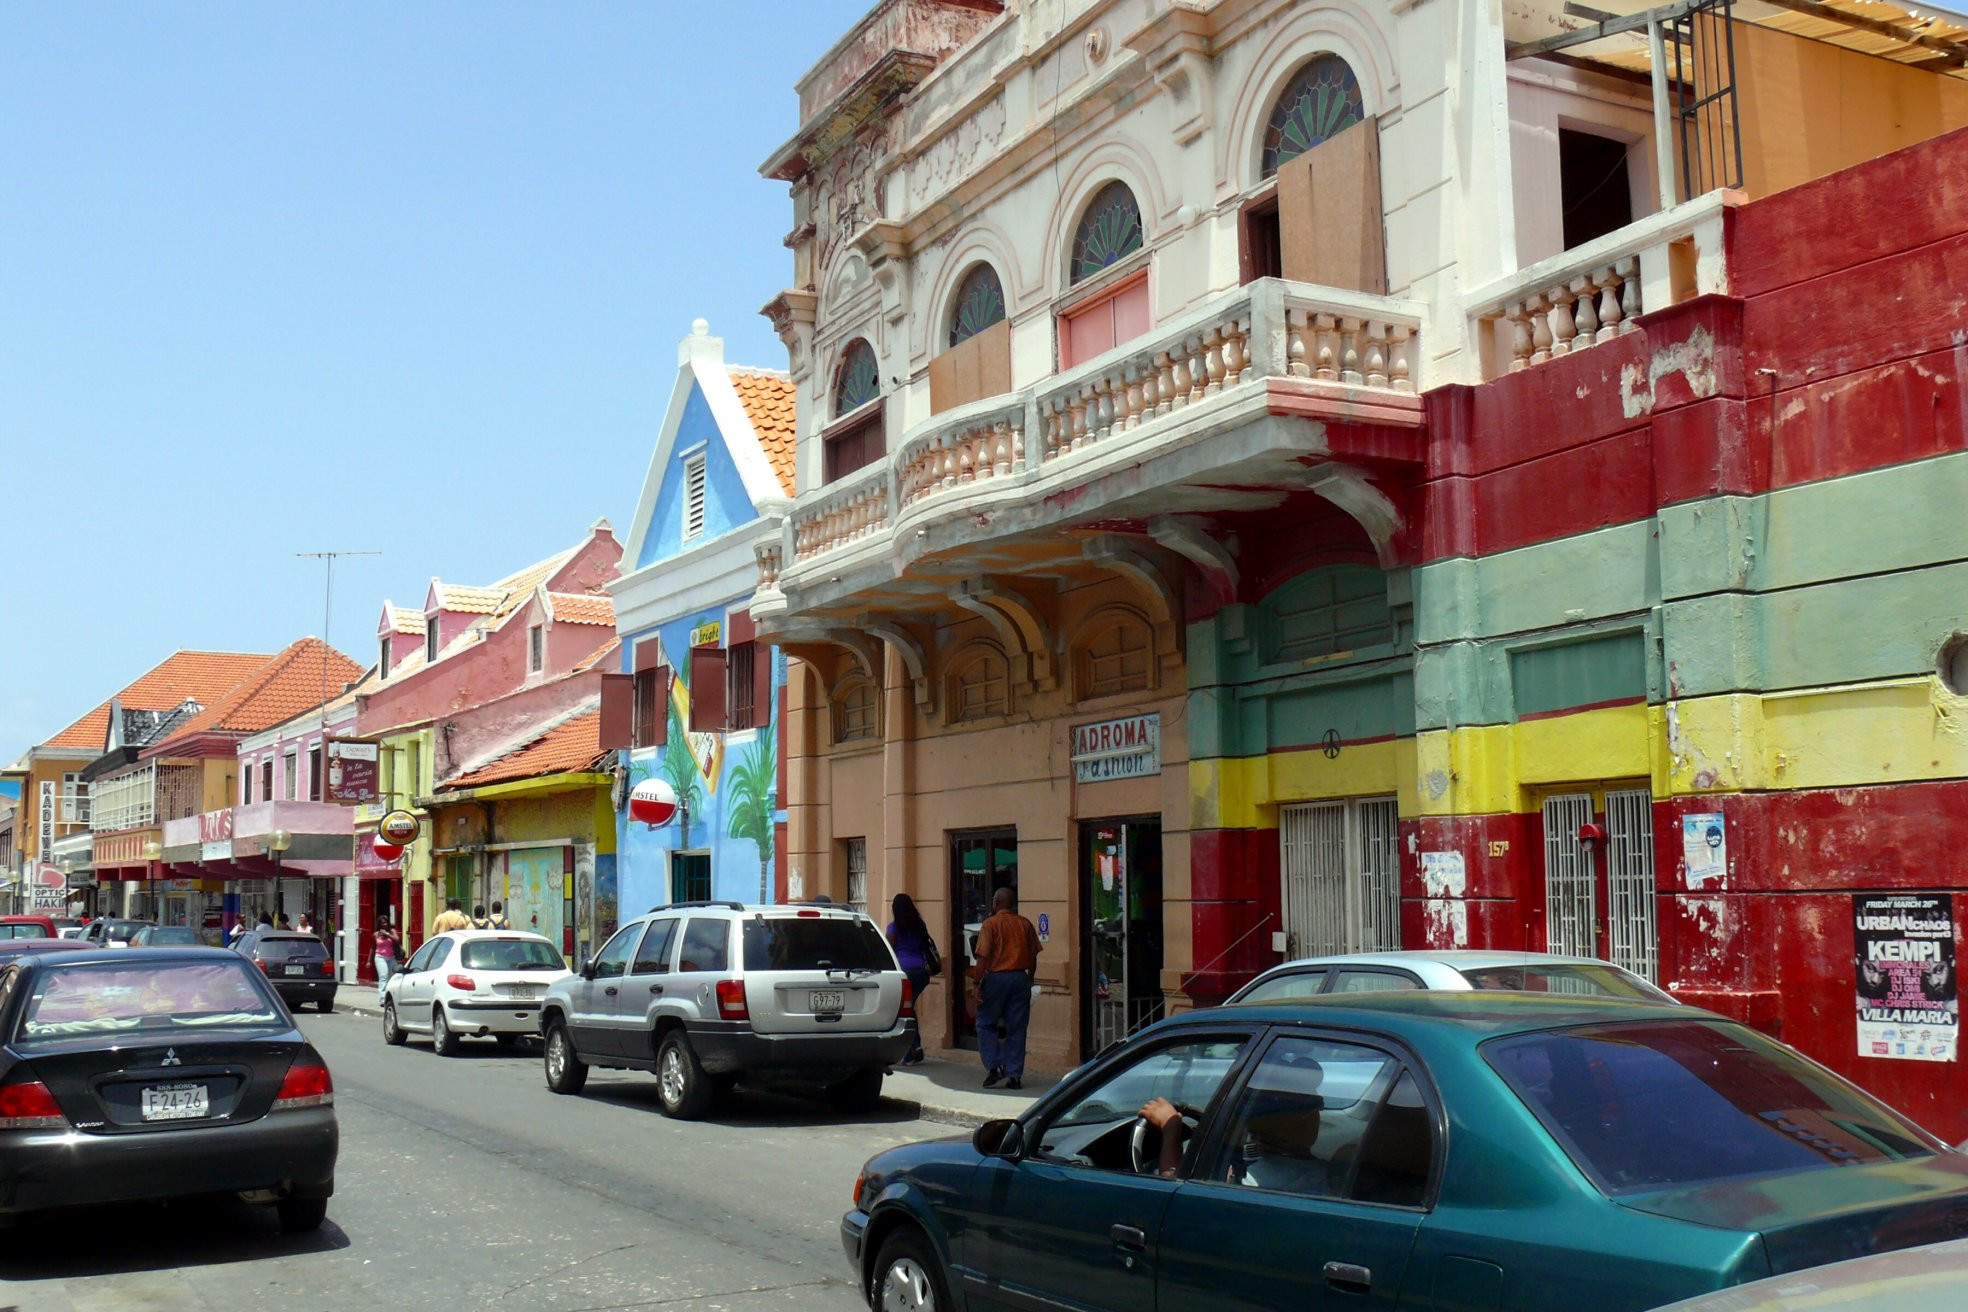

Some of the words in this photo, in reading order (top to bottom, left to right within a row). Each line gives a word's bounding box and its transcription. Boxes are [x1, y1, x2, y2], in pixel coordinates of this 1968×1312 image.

[699, 625, 719, 643] bright
[1079, 719, 1147, 753] ADROMA
[42, 782, 52, 863] KADEWE
[35, 889, 70, 897] OPTIC
[1866, 901, 1892, 909] FRIDAY
[1893, 900, 1921, 908] MARCH
[1867, 940, 1941, 962] KEMPI
[1888, 969, 1911, 977] AREA
[1890, 976, 1902, 985] DJ
[1891, 984, 1902, 992] DJ
[1871, 999, 1884, 1007] MC
[1885, 999, 1911, 1008] CHRIS
[1911, 1000, 1945, 1009] STRICK
[1862, 1008, 1902, 1022] VILLA
[1902, 1009, 1953, 1024] MARIA
